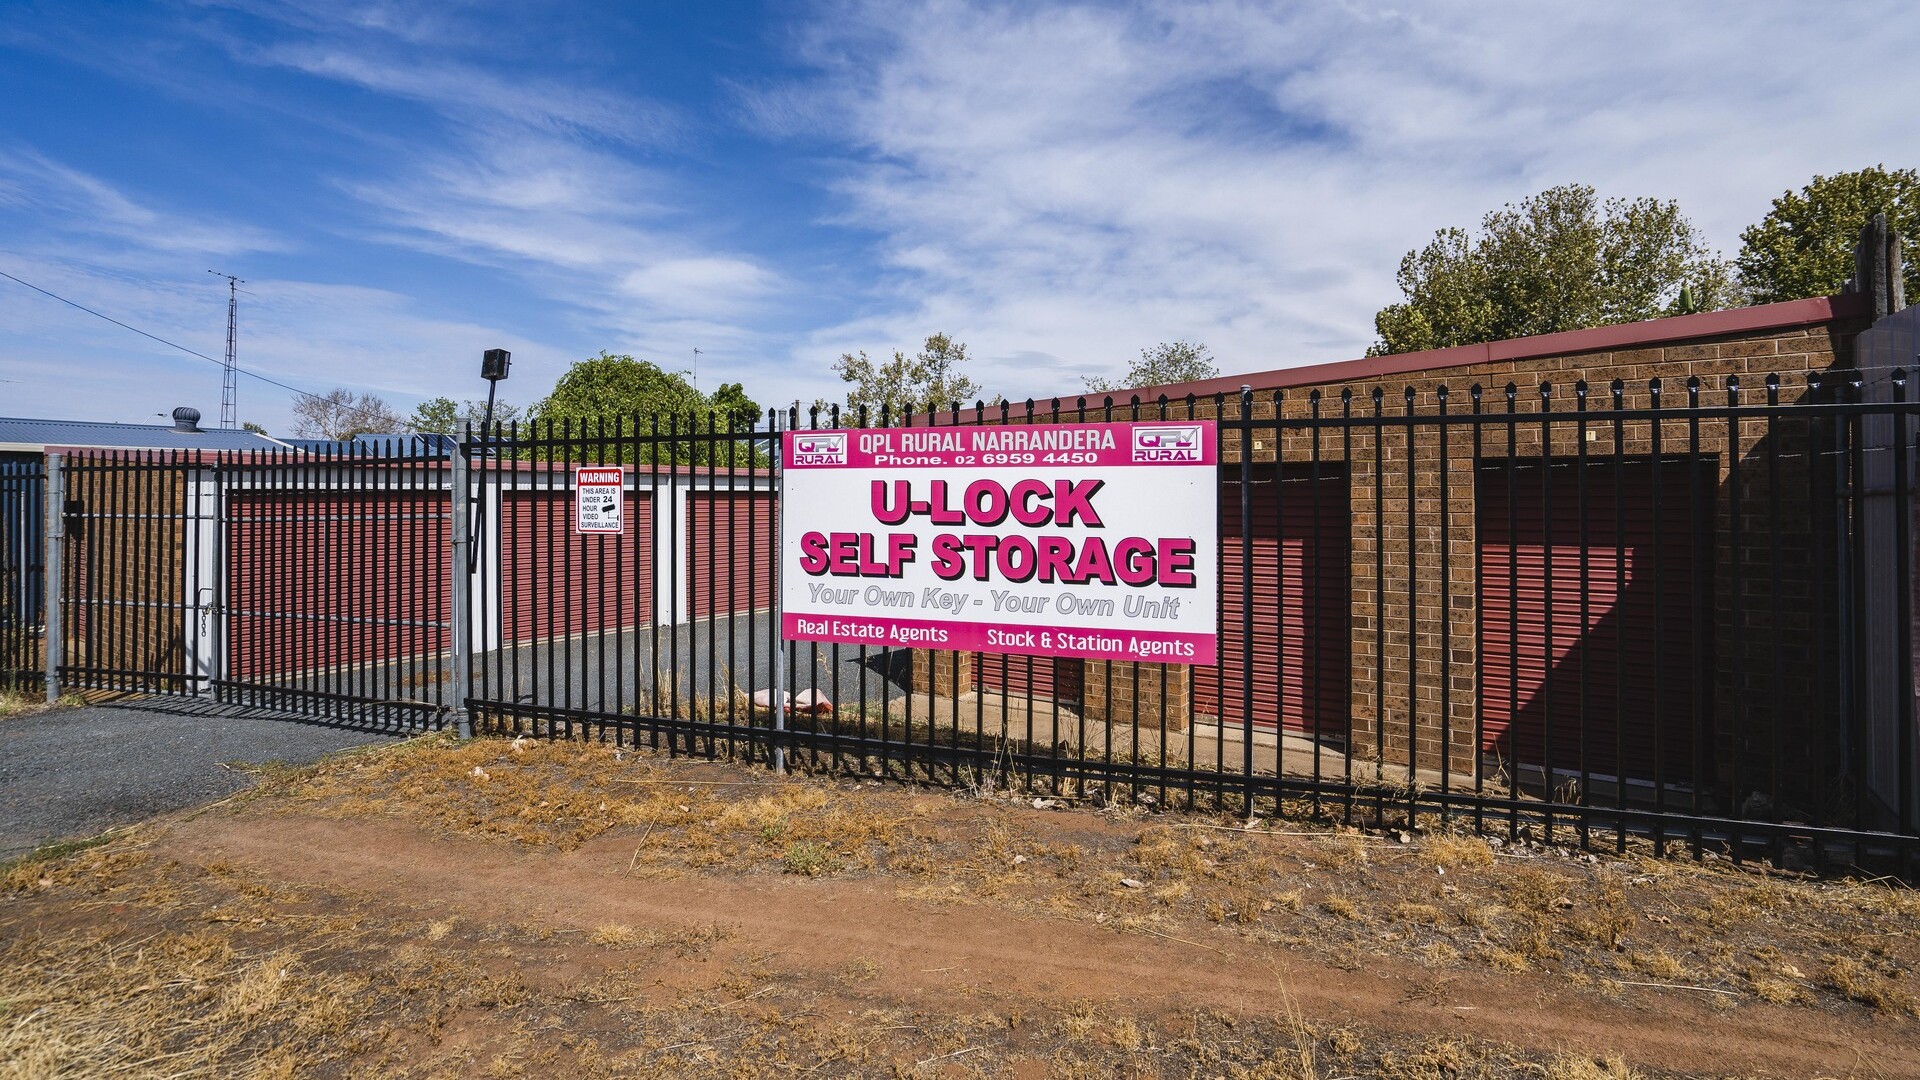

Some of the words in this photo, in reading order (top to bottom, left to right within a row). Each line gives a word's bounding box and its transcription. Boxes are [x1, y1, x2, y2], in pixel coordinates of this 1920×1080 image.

[798, 438, 839, 453] QPL
[859, 434, 895, 455] QPL
[901, 432, 966, 453] RURAL
[972, 429, 1116, 452] NARRANDERA
[1138, 430, 1193, 448] QPL
[795, 455, 843, 465] RURAL
[874, 454, 948, 466] Phone.
[954, 455, 976, 465] 02
[982, 453, 1036, 464] 6959
[1042, 452, 1099, 464] 4450
[1134, 450, 1198, 461] RURAL
[579, 472, 620, 483] WARNING
[602, 495, 613, 503] 24
[870, 479, 1105, 528] U-LOCK
[799, 531, 918, 580] SELF
[931, 533, 1196, 588] STORAGE
[808, 582, 859, 605] Your
[864, 585, 915, 607] Own
[921, 588, 969, 615] Key
[990, 590, 1050, 614] Your
[1055, 592, 1115, 617] Own
[1123, 595, 1180, 620] Unit
[797, 619, 829, 635] Real
[833, 621, 885, 639] Estate
[889, 624, 948, 643] Agents
[987, 629, 1036, 648] Stock
[1040, 632, 1052, 649] &
[1057, 632, 1123, 653] Station
[1128, 636, 1195, 657] Agents
